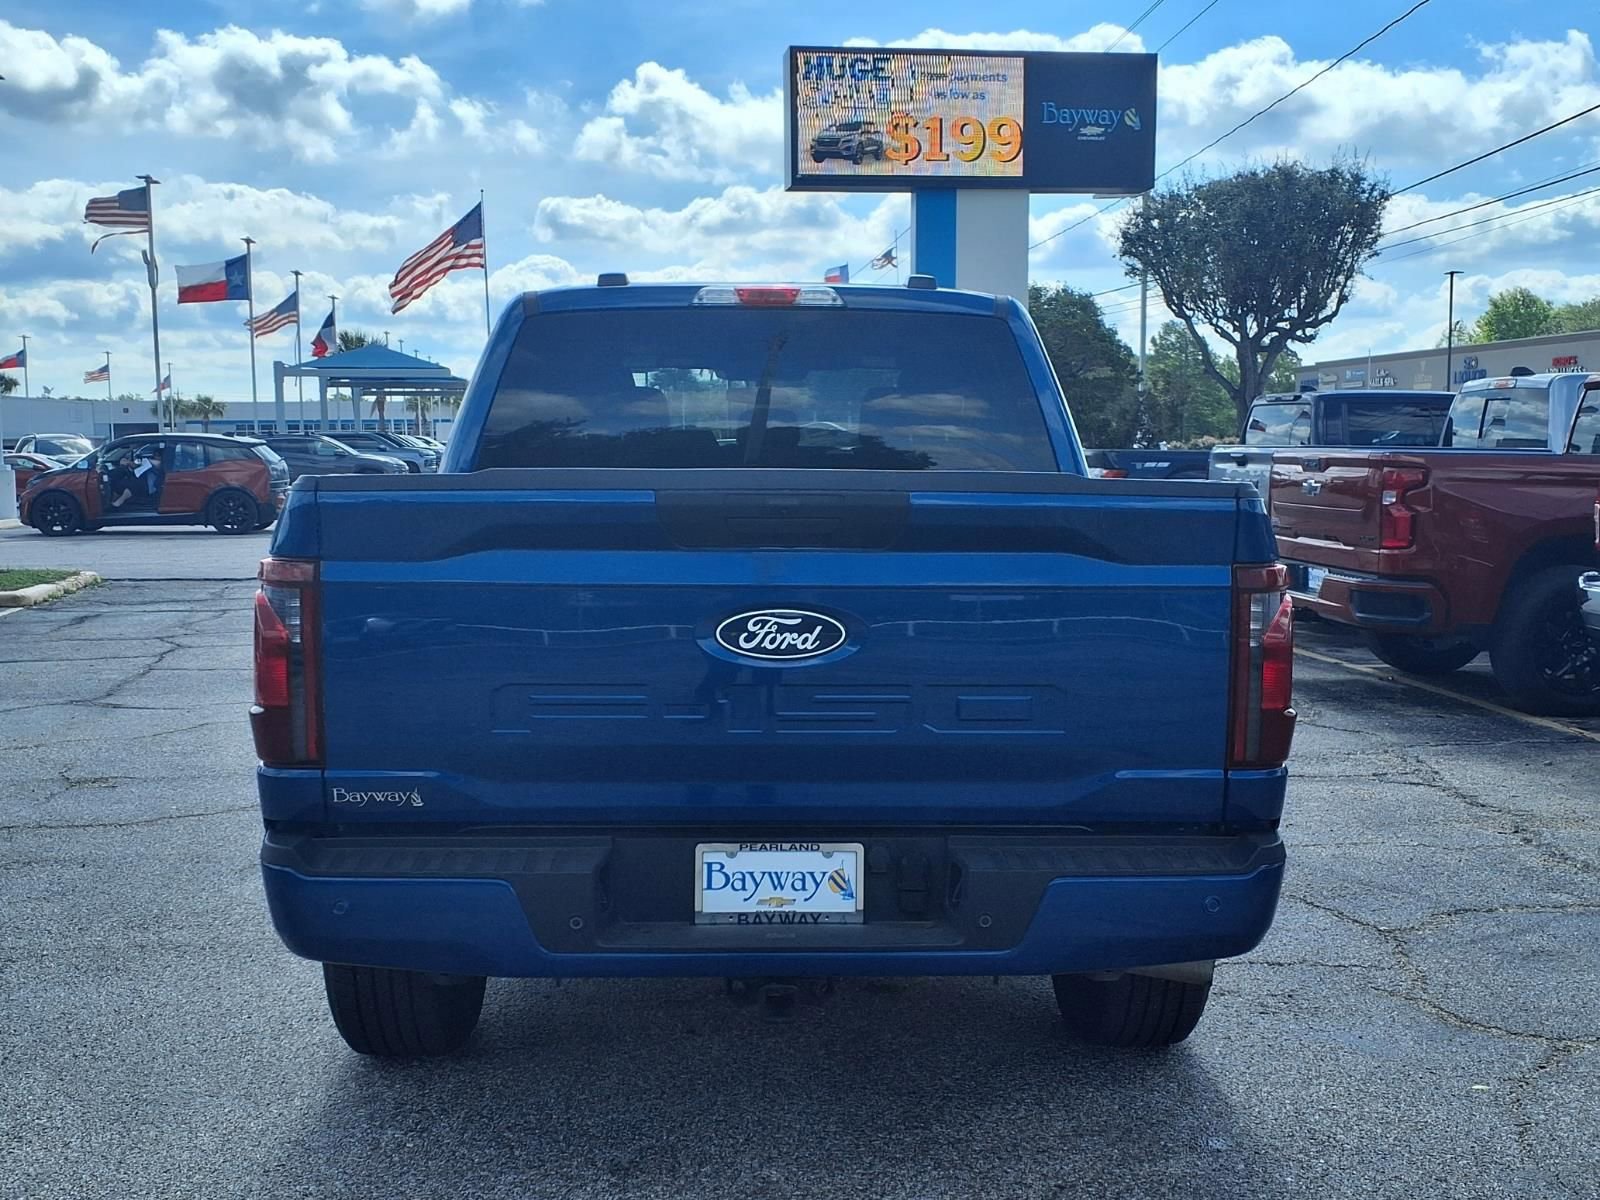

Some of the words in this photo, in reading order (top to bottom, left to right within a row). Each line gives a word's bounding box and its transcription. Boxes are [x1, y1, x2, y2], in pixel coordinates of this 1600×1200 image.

[803, 55, 892, 81] HUGE
[972, 91, 986, 100] as
[1041, 102, 1121, 132] Bayway
[885, 112, 1022, 165] $199
[738, 616, 823, 650] Ford
[332, 787, 410, 808] Bayway
[739, 843, 820, 852] PEARLAND
[703, 861, 829, 902] Bayway
[737, 912, 822, 925] BAYWAY
